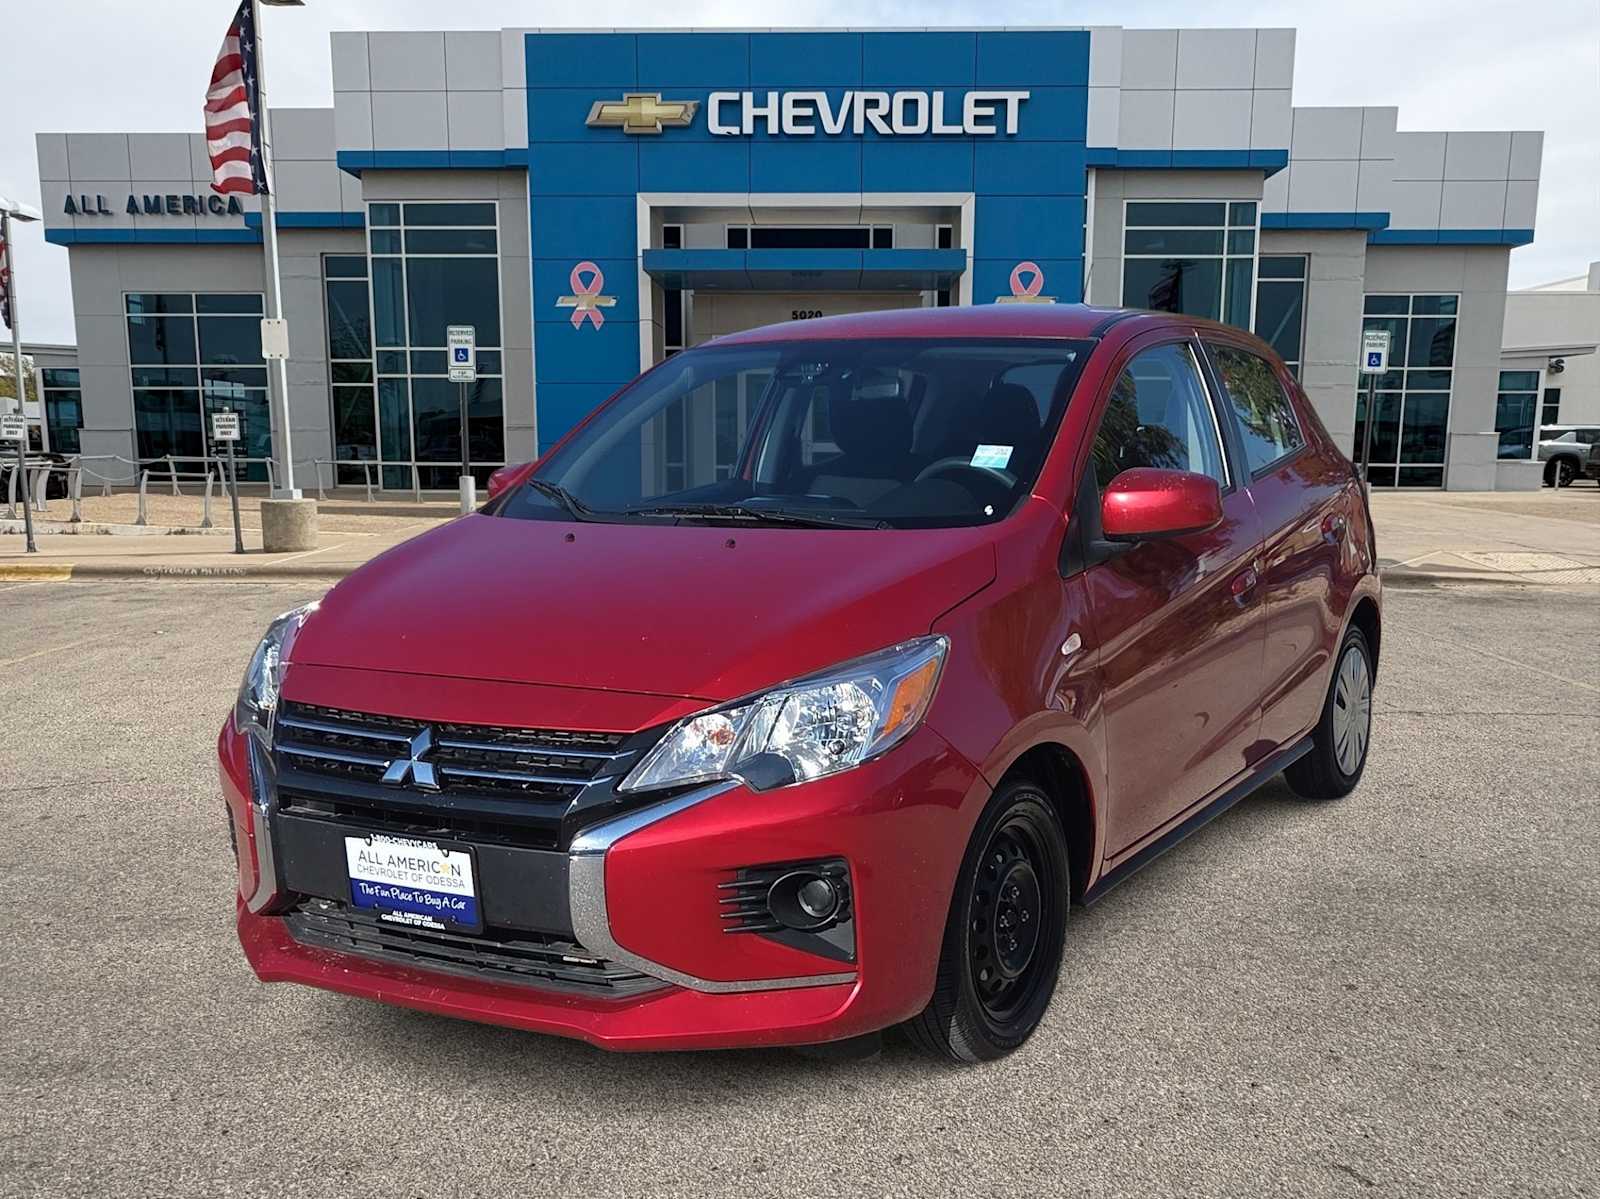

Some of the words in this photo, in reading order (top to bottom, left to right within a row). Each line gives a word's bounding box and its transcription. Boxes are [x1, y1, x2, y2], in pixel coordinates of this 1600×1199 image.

[707, 90, 1030, 135] CHEVROLET
[64, 194, 113, 215] ALL
[792, 310, 823, 320] 5020
[358, 850, 383, 866] ALL
[356, 863, 409, 881] CHEVROLET
[412, 873, 423, 882] OF
[425, 874, 466, 889] ODESSA
[359, 882, 375, 896] The
[374, 885, 391, 898] Fun
[391, 887, 413, 902] Place
[412, 891, 423, 904] To
[424, 893, 441, 910] Buy
[442, 896, 451, 909] A
[451, 897, 467, 910] Car
[380, 913, 413, 926] CHEVROLET
[413, 918, 422, 927] OF
[422, 919, 446, 931] ODESSA
[392, 910, 403, 918] ALL
[403, 911, 433, 922] AMERICAN
